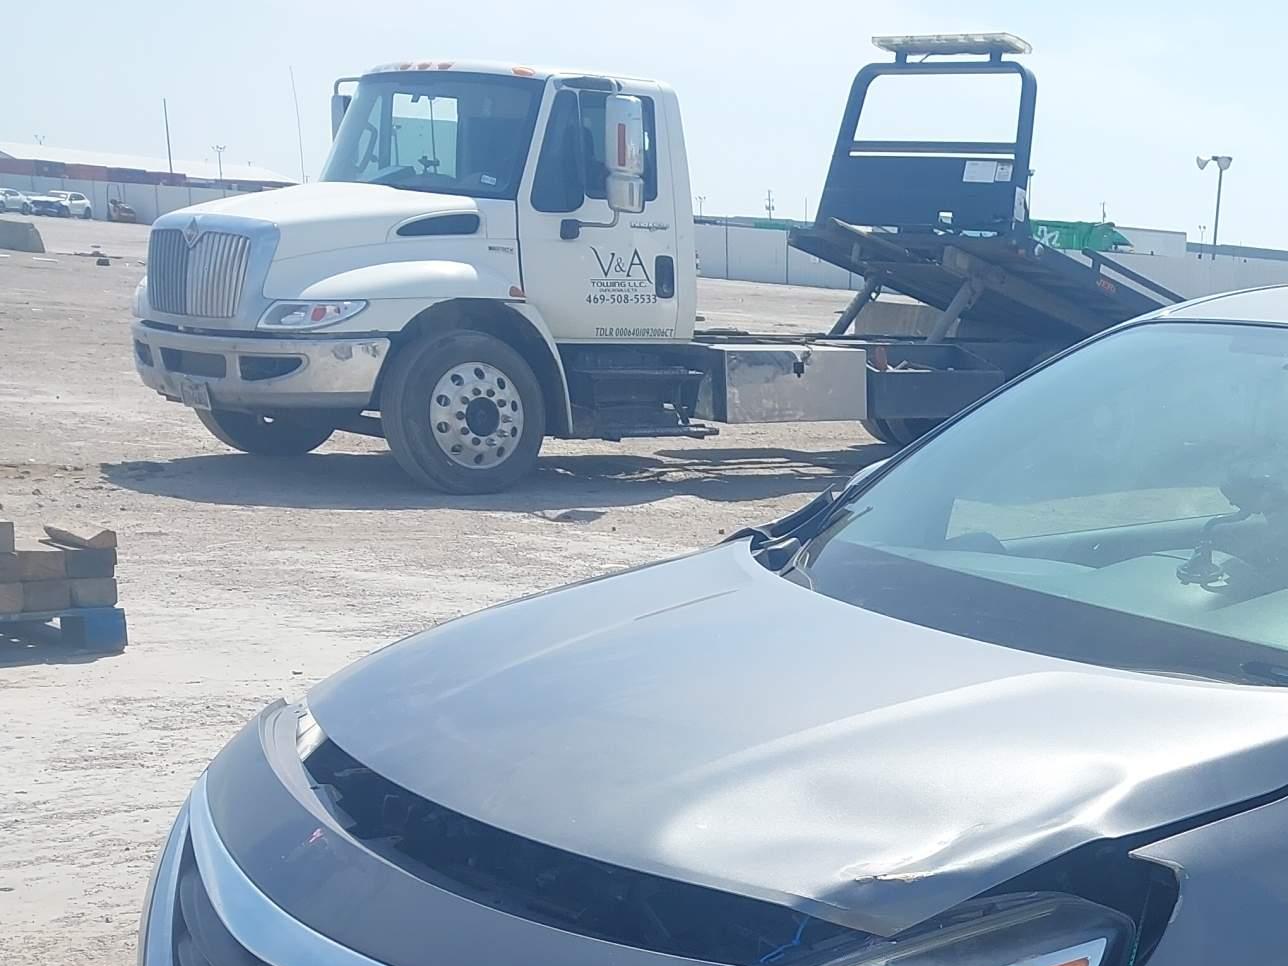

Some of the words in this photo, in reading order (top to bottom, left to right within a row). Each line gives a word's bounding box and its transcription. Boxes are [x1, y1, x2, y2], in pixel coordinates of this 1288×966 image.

[590, 246, 653, 284] V&A
[586, 294, 657, 304] 469-508-5533
[595, 327, 614, 337] TDLR
